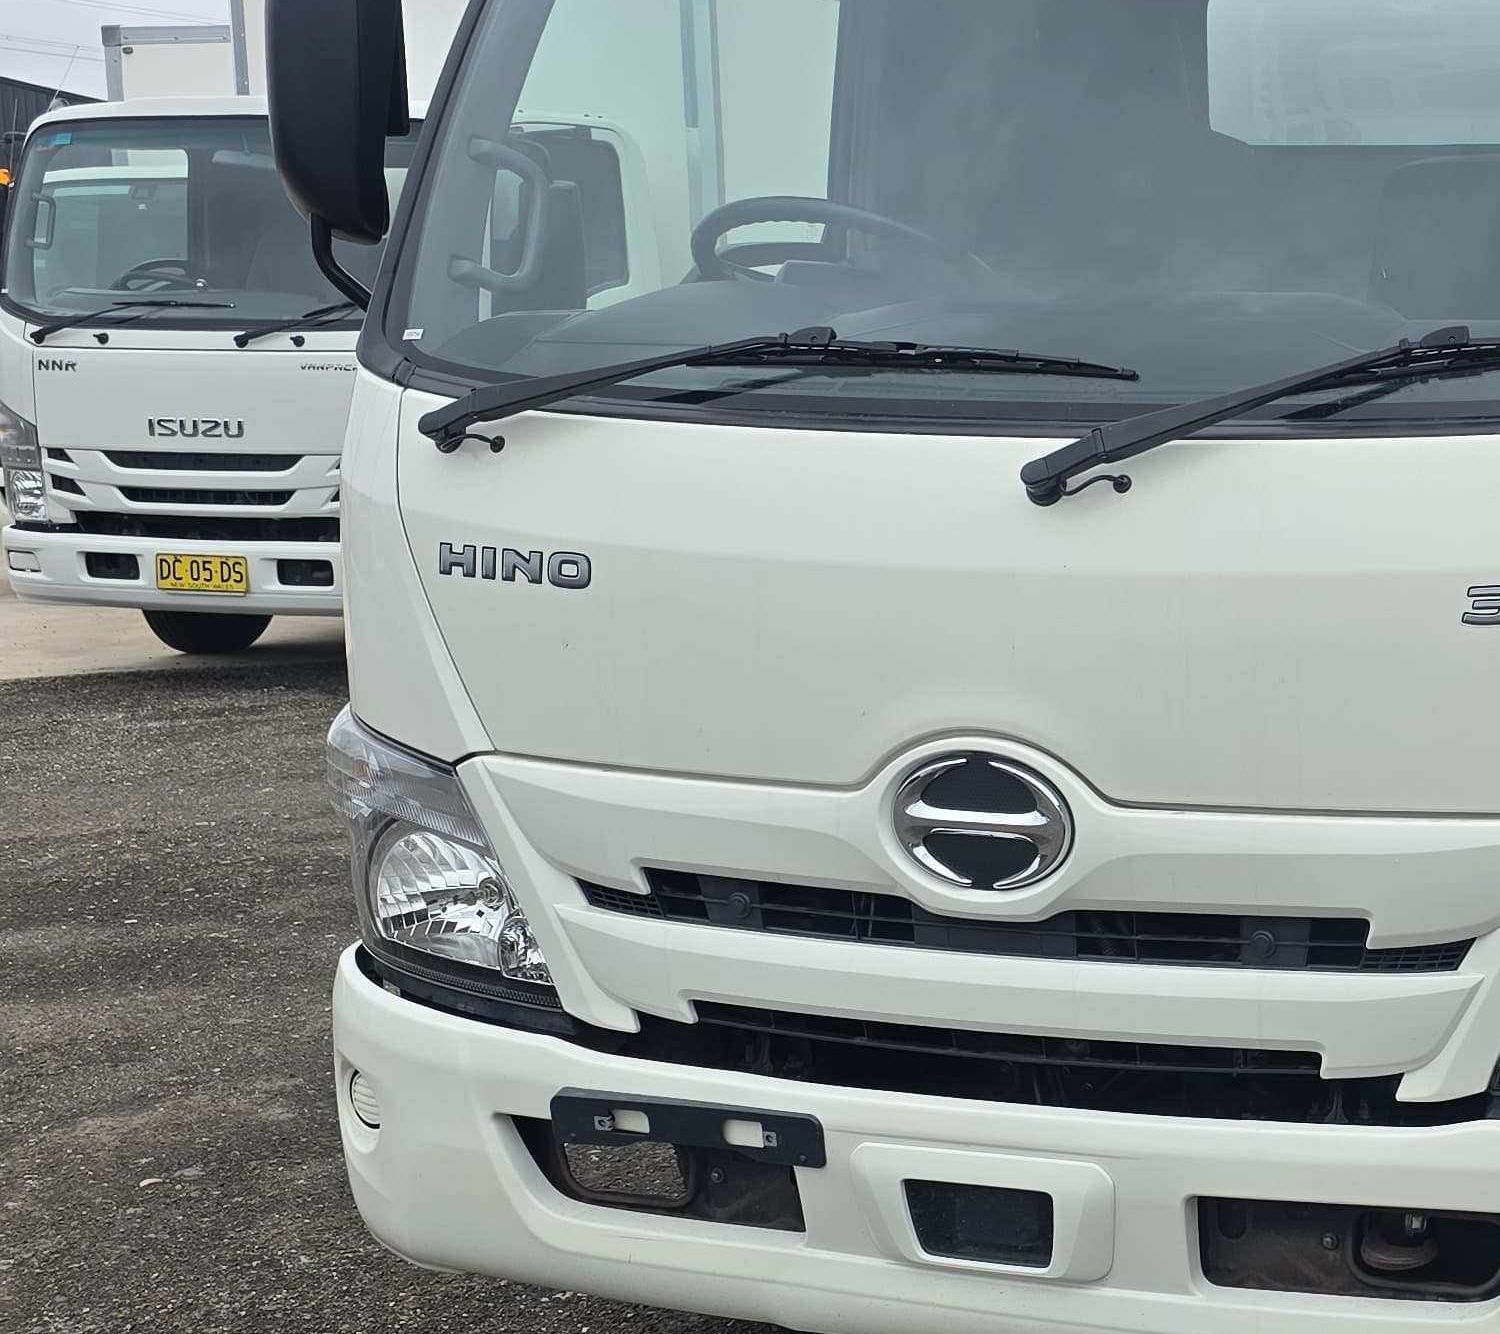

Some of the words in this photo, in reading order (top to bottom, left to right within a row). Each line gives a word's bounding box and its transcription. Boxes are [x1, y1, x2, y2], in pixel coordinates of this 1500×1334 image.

[38, 359, 77, 372] NNR
[147, 417, 245, 438] ISUZU
[439, 542, 592, 590] HINO
